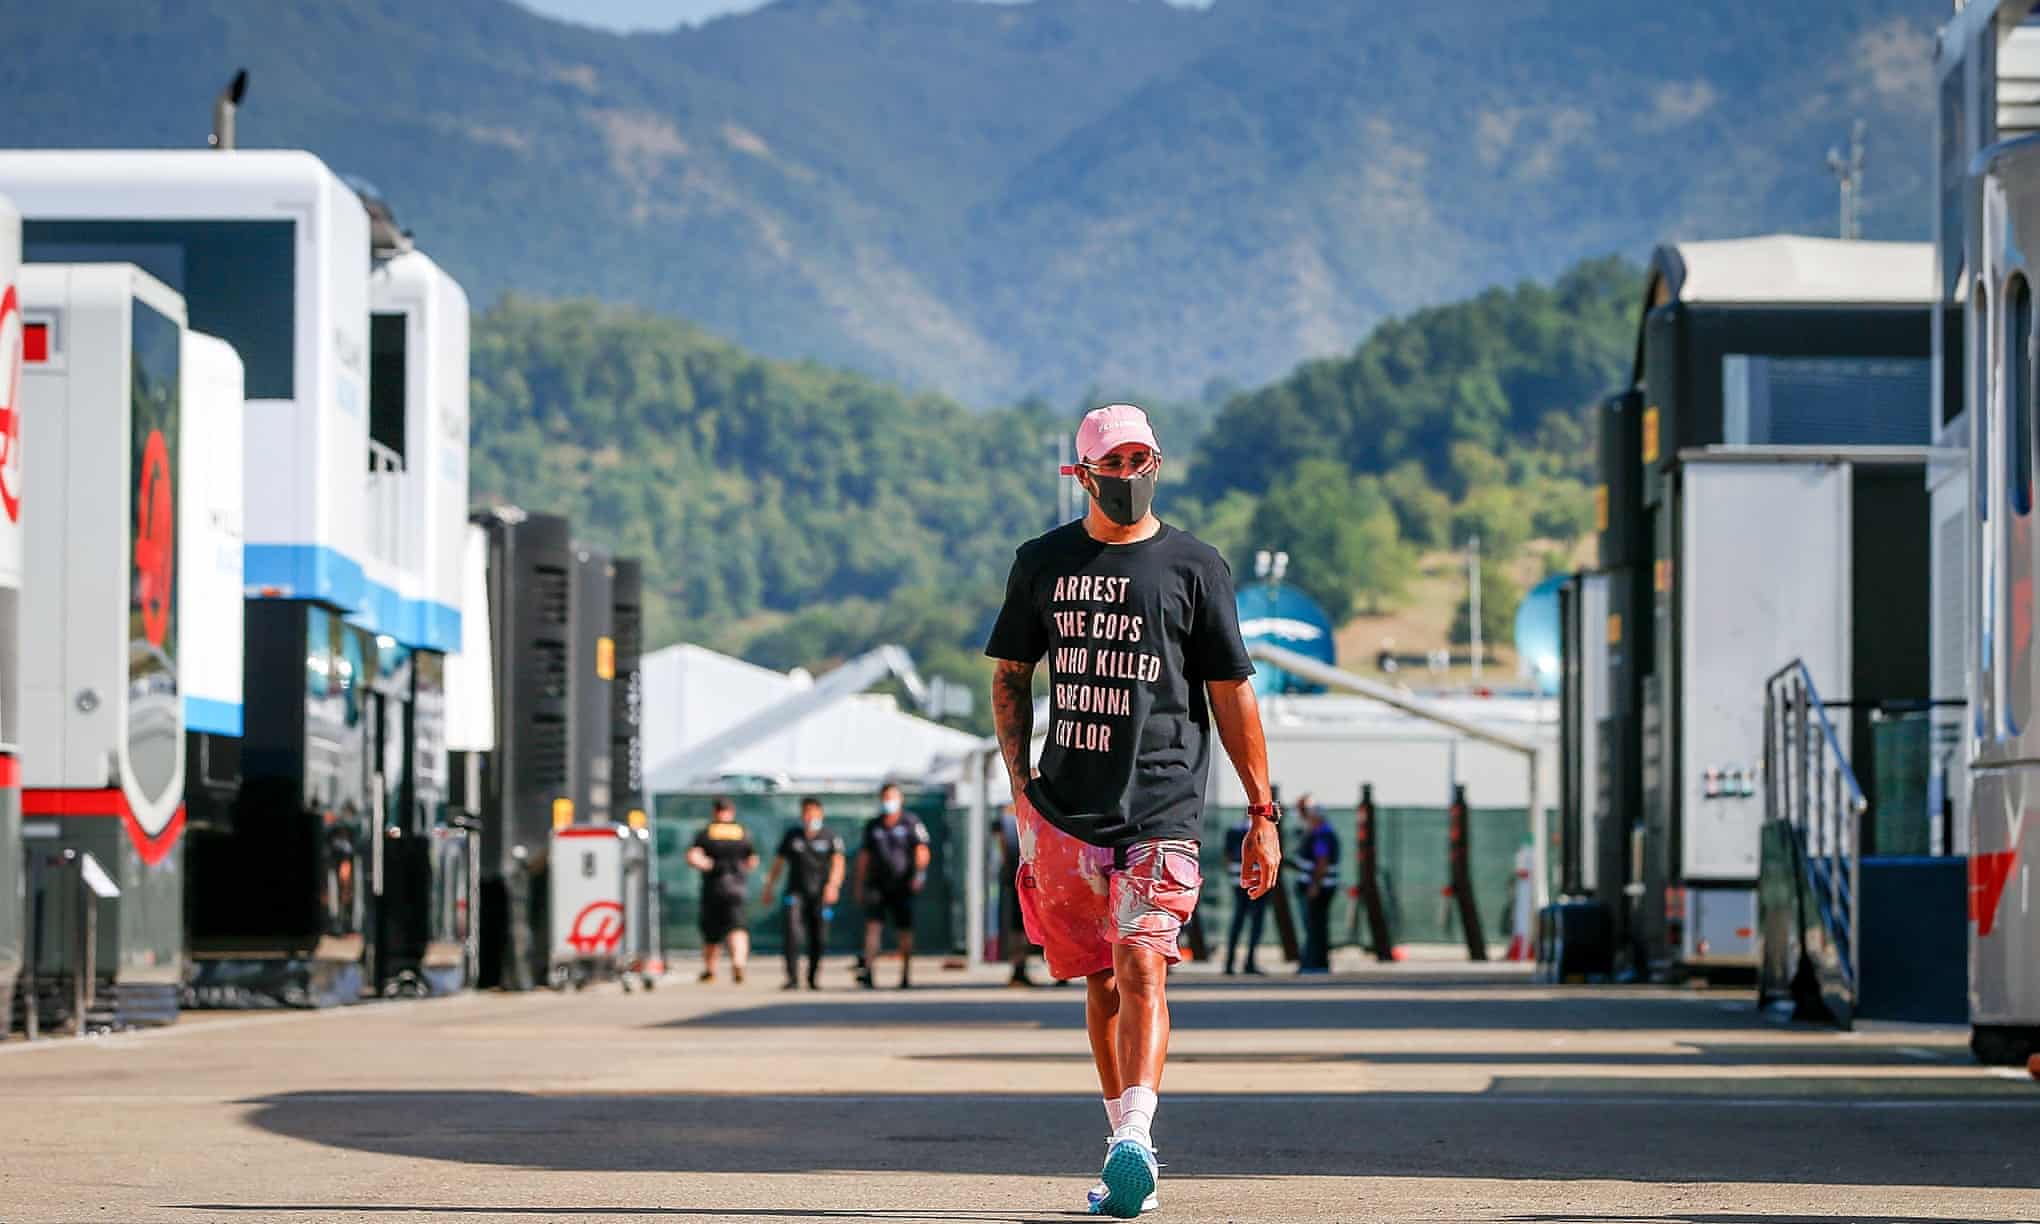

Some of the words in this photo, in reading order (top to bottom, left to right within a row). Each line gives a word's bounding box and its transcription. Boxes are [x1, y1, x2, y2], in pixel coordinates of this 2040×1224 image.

[1053, 575, 1130, 603] ARREST
[1053, 611, 1087, 639] THE
[1092, 613, 1143, 642] COPS
[1055, 647, 1088, 675] WHO
[1095, 650, 1161, 682] KILLED
[1056, 683, 1130, 716] BREONNA
